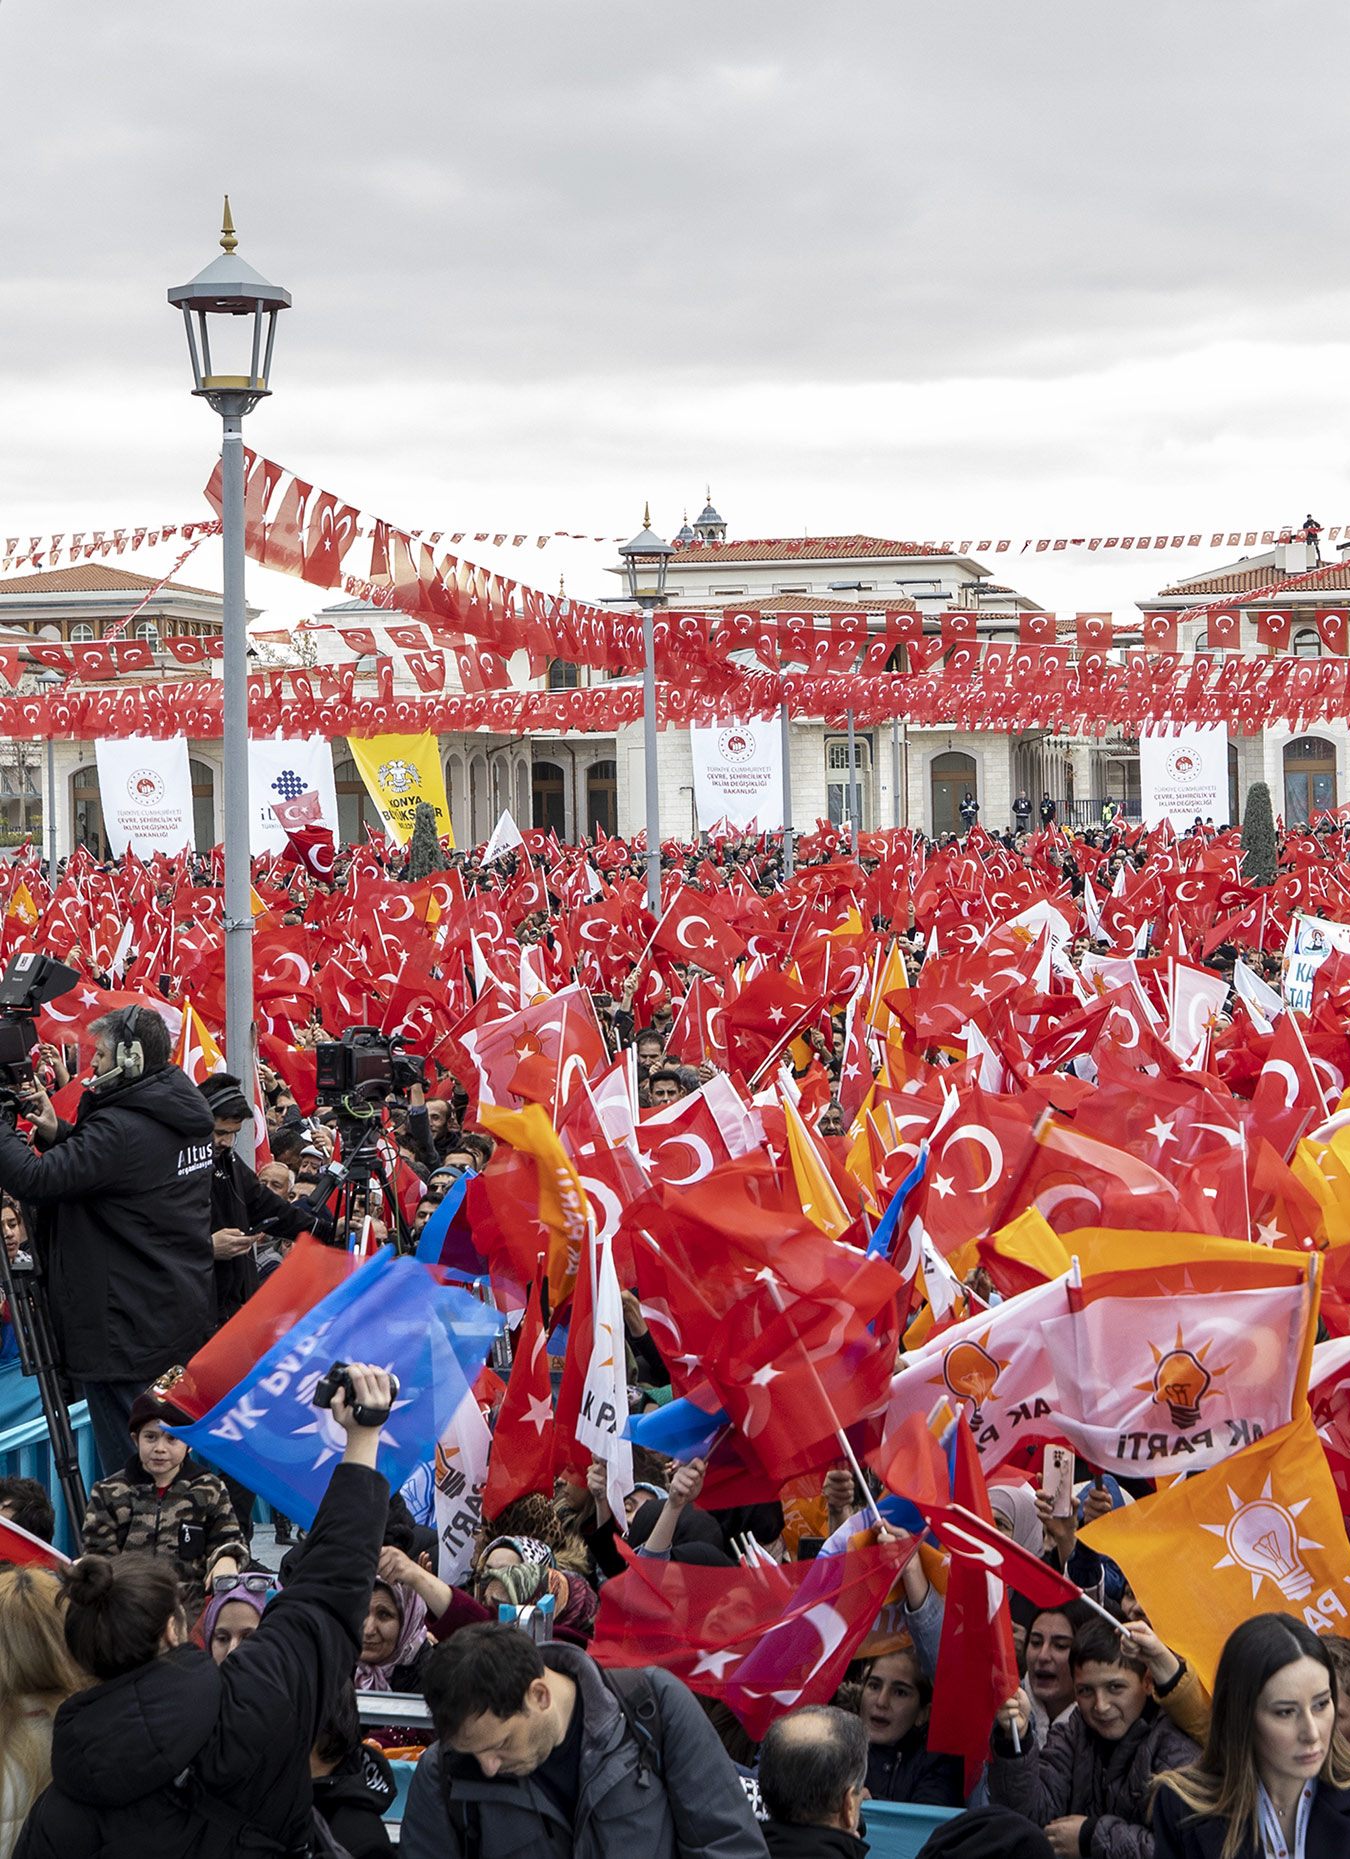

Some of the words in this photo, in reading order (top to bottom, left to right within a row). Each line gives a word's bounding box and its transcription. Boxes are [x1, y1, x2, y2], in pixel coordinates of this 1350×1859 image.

[389, 795, 423, 808] KONYA
[1295, 962, 1313, 983] KA
[1290, 987, 1313, 1009] TAR
